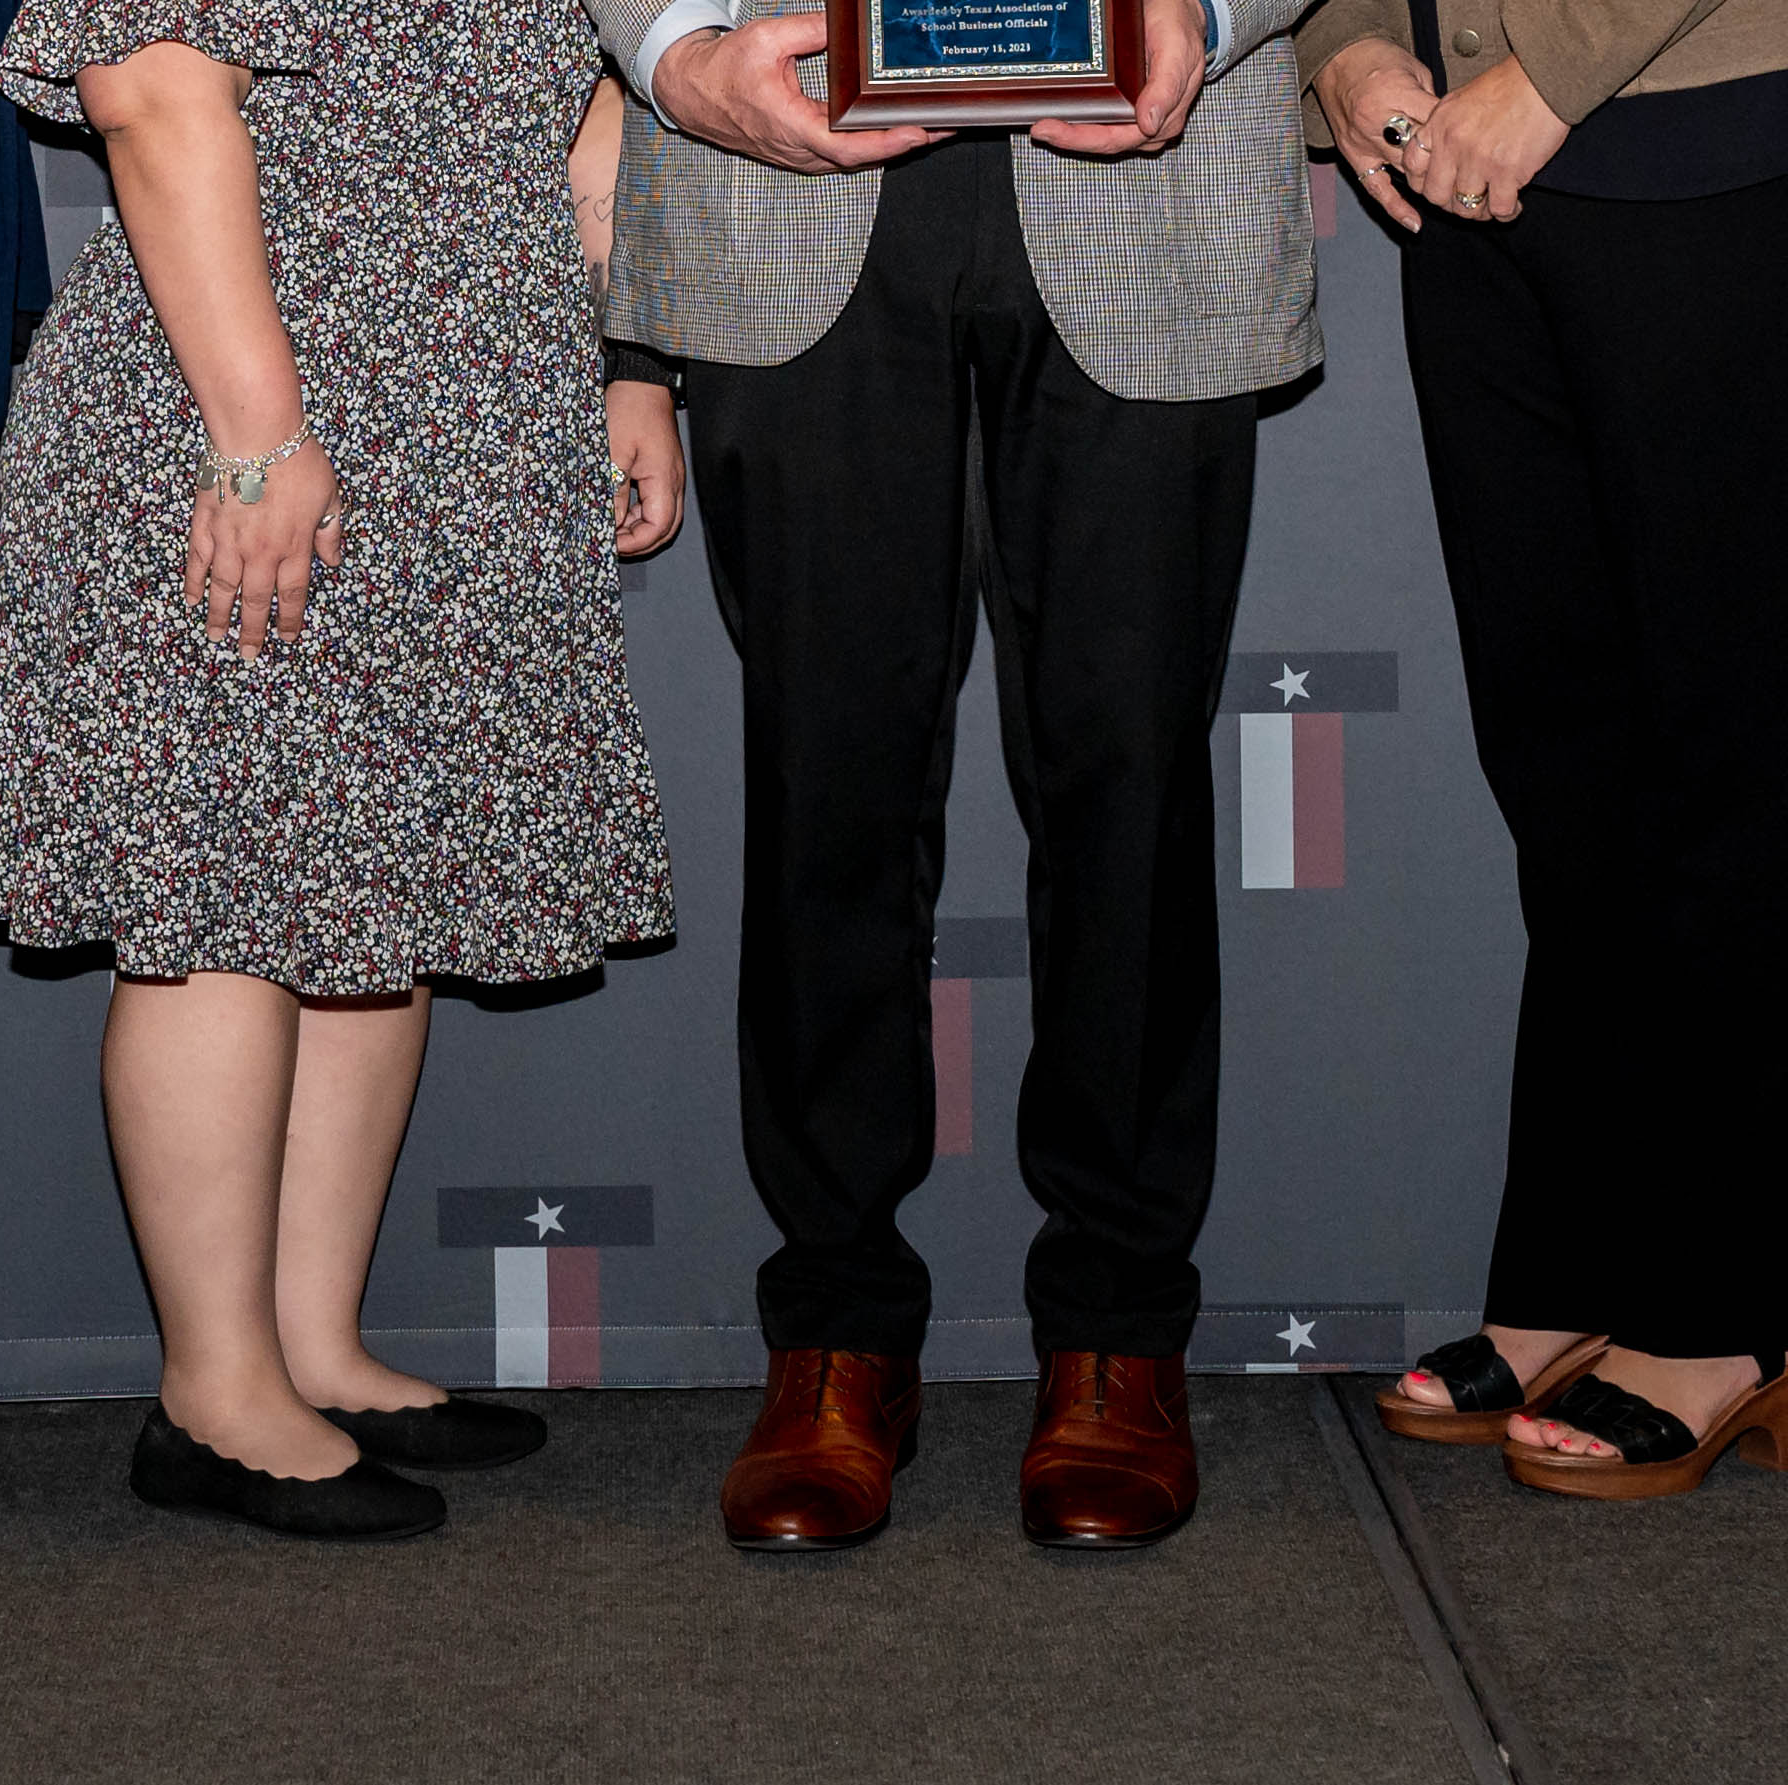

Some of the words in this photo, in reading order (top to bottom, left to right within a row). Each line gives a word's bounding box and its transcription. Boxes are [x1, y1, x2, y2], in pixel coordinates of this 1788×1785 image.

[901, 6, 948, 17] Awarded
[950, 5, 963, 18] by
[964, 4, 992, 15] Texas
[994, 2, 1054, 14] Association
[1055, 1, 1069, 12] of
[921, 21, 956, 32] School
[958, 19, 1003, 31] Business
[1004, 17, 1049, 29] Officials
[942, 45, 990, 56] February
